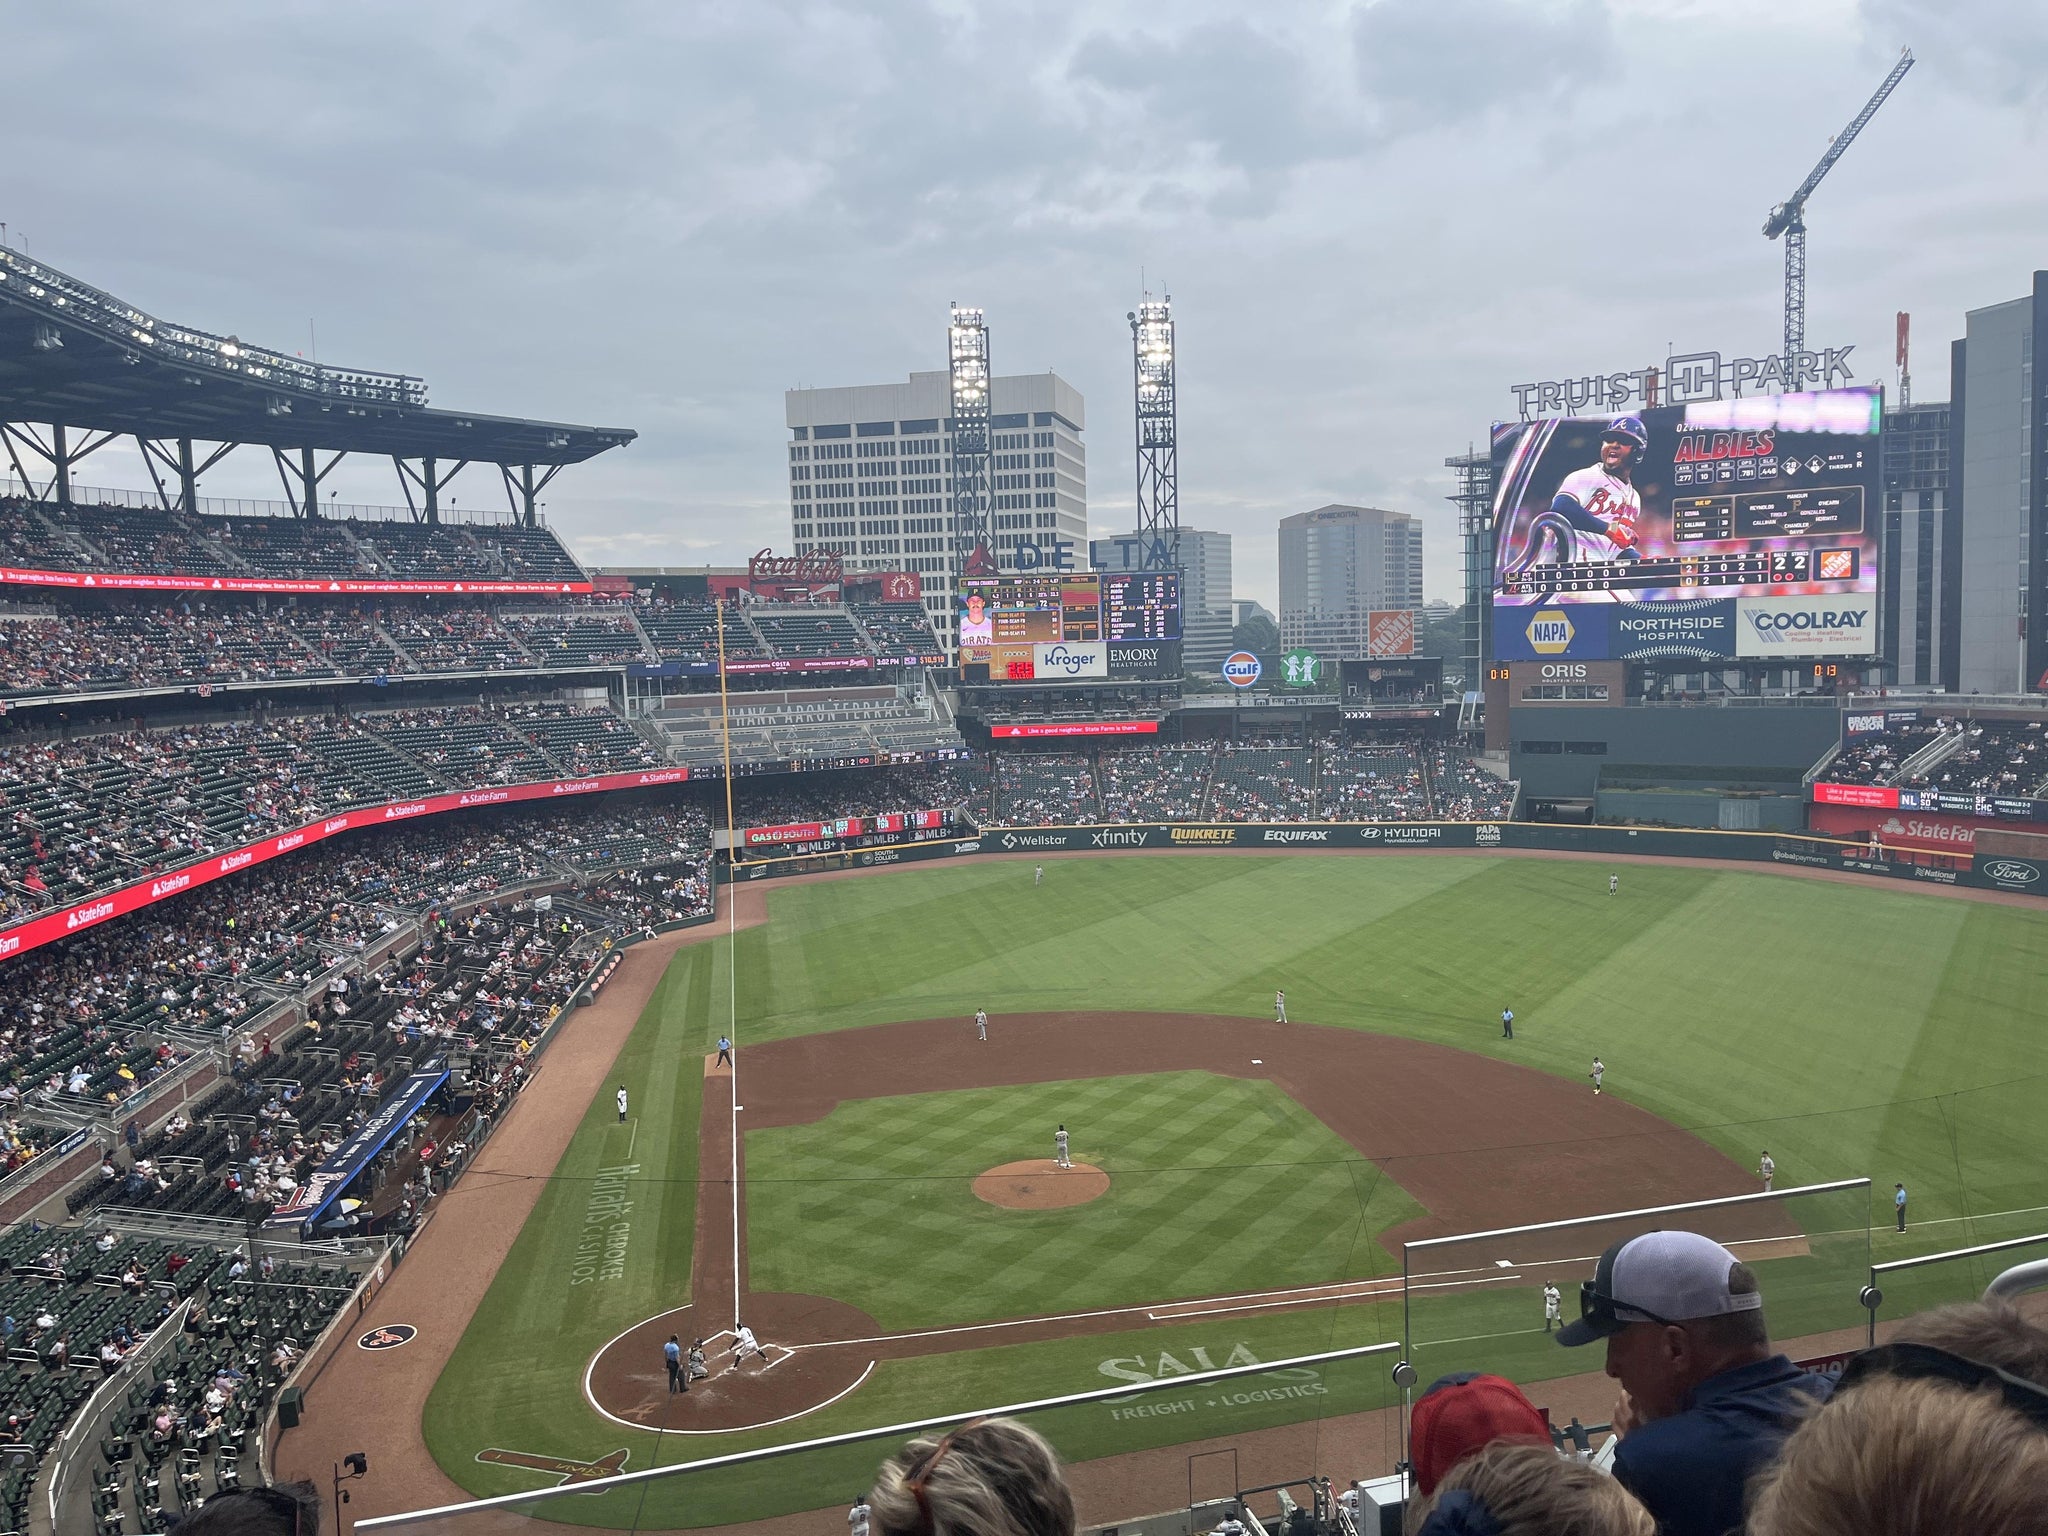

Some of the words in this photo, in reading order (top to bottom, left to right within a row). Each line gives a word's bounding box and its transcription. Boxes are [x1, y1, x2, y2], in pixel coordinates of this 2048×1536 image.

[1511, 368, 1657, 413] TRUIST
[1732, 345, 1856, 390] PARK
[1674, 429, 1775, 463] ALBIES
[1016, 538, 1174, 569] DELTA
[1775, 557, 1785, 569] 2
[1794, 556, 1805, 569] 2
[1821, 551, 1851, 577] HOME
[1556, 571, 1562, 579] 0
[1587, 570, 1593, 578] 0
[1686, 565, 1692, 573] 2
[1703, 564, 1709, 572] 2
[1721, 563, 1727, 571] 0
[1739, 562, 1745, 570] 2
[1556, 583, 1562, 591] 0
[1686, 577, 1692, 585] 0
[1703, 576, 1709, 584] 2
[1738, 575, 1745, 583] 4
[1374, 616, 1391, 632] THE
[1620, 617, 1725, 631] NORTHSIDE
[1754, 610, 1868, 630] COOLRAY
[1370, 611, 1414, 654] HOME
[1534, 622, 1567, 641] NAPA
[1638, 631, 1704, 640] HOSPITAL
[1387, 625, 1414, 654] DEPOT
[1045, 646, 1096, 674] Kroger
[1110, 648, 1159, 661] EMORY
[876, 658, 889, 666] 3:02
[1225, 663, 1259, 675] Gulf
[1490, 669, 1510, 680] 0:13
[1541, 664, 1587, 678] ORIS
[1814, 664, 1836, 677] 0:13
[727, 706, 777, 727] HANK
[776, 703, 836, 724] AARON
[832, 700, 912, 720] TERRACE
[1848, 715, 1884, 724] BRAVES
[1848, 722, 1884, 731] VISION
[1827, 794, 1842, 802] State
[1843, 795, 1857, 803] Farm
[1901, 795, 1917, 805] NL
[1920, 792, 1938, 800] NYM
[751, 832, 771, 843] GAS
[783, 828, 815, 839] SOUTH
[821, 825, 833, 836] AL
[925, 828, 952, 839] MLB+
[1170, 828, 1236, 841] QUIKRETE
[1384, 828, 1441, 838] HYUNDAI
[1476, 825, 1500, 834] PAPA
[1907, 819, 1976, 843] StateFar
[873, 833, 900, 844] MLB+
[1020, 836, 1067, 846] Wellstar
[1091, 828, 1147, 848] xfinity
[1264, 830, 1328, 843] EQUIFAX
[1475, 833, 1500, 841] JOHNS
[808, 841, 836, 851] MLB+
[1925, 869, 1956, 880] National
[1993, 863, 2030, 880] Ford
[570, 1225, 604, 1285] CASINOS
[599, 1222, 631, 1281] CHEROKEE
[1098, 1341, 1262, 1404] SAIA
[1111, 1399, 1196, 1421] FREIGHT
[1221, 1383, 1329, 1407] LOGISTICS
